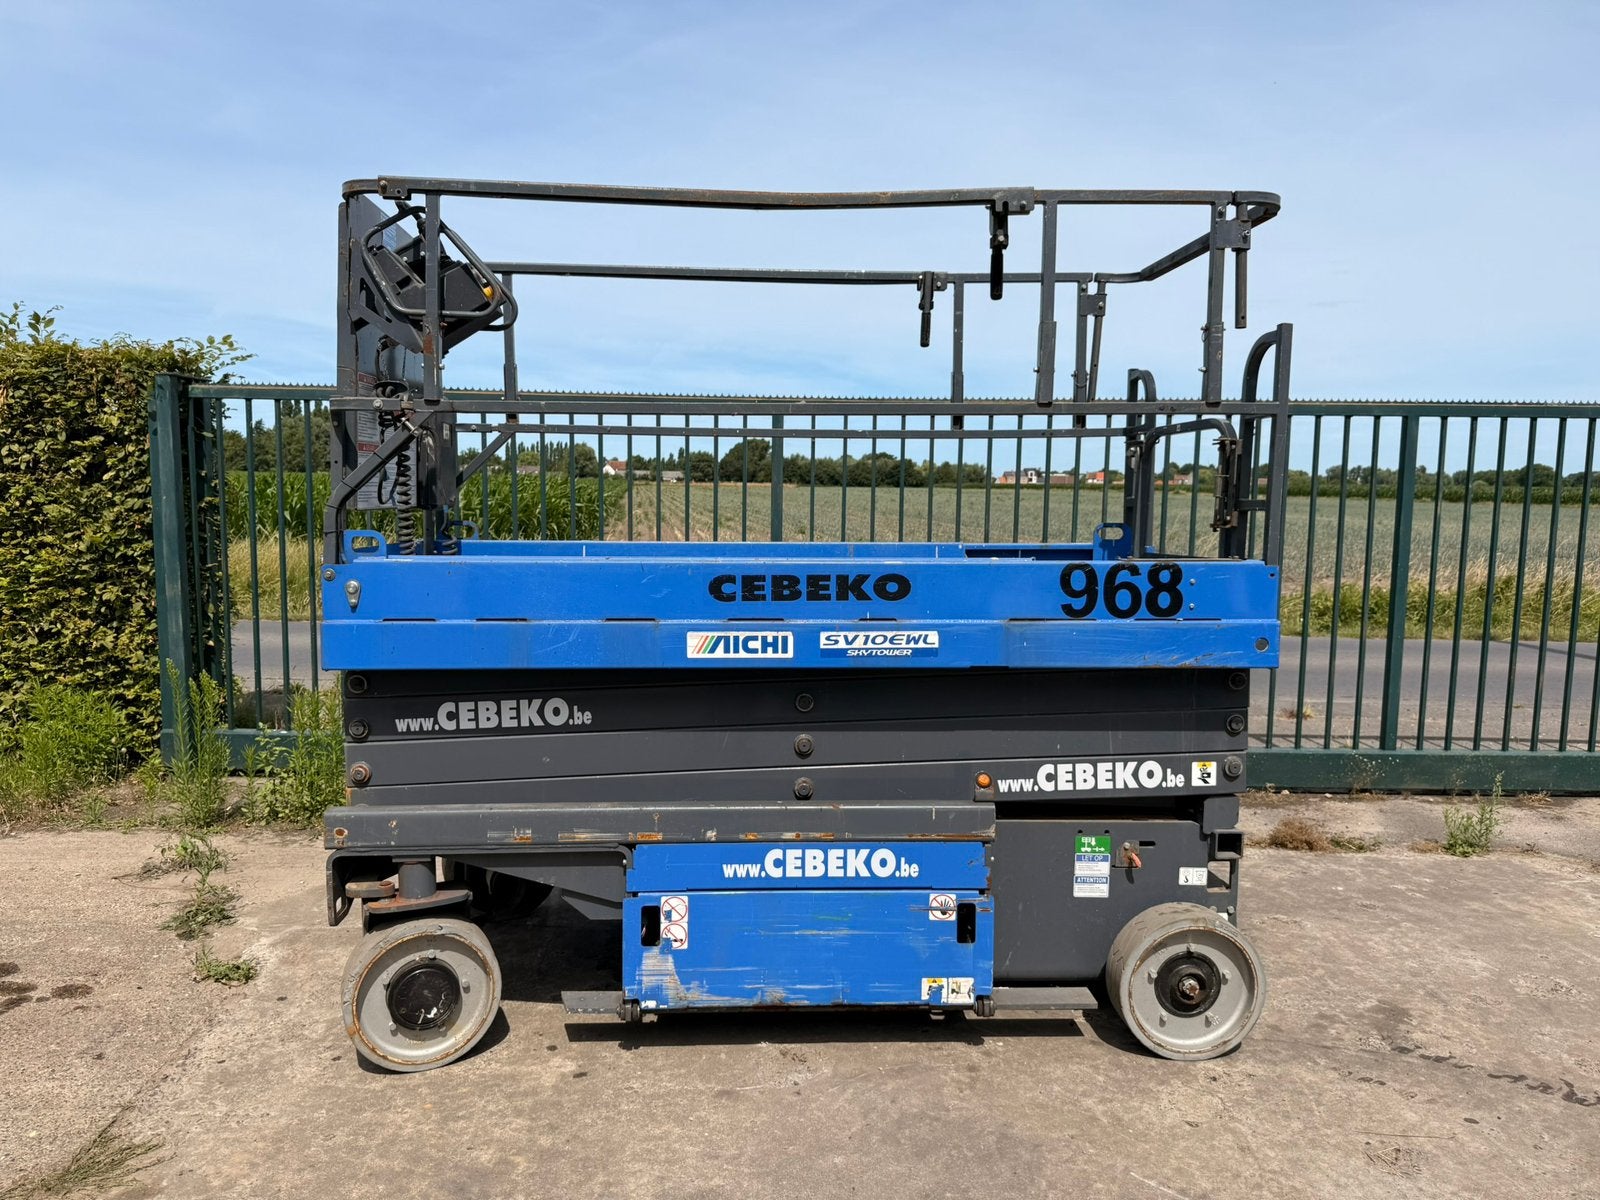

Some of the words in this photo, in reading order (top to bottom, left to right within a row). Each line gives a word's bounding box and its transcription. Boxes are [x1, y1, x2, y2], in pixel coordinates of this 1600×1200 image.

[708, 573, 912, 602] CEBEKO
[1059, 562, 1184, 619] 968
[707, 635, 789, 654] AICHI
[822, 634, 937, 646] SV10EWL
[846, 648, 913, 657] SKYTOWER
[395, 698, 593, 732] www.CEBEKO.be
[998, 761, 1185, 793] www.CEBEKO.be
[722, 848, 920, 878] www.CEBEKO.be
[1076, 876, 1107, 884] ATTENTION
